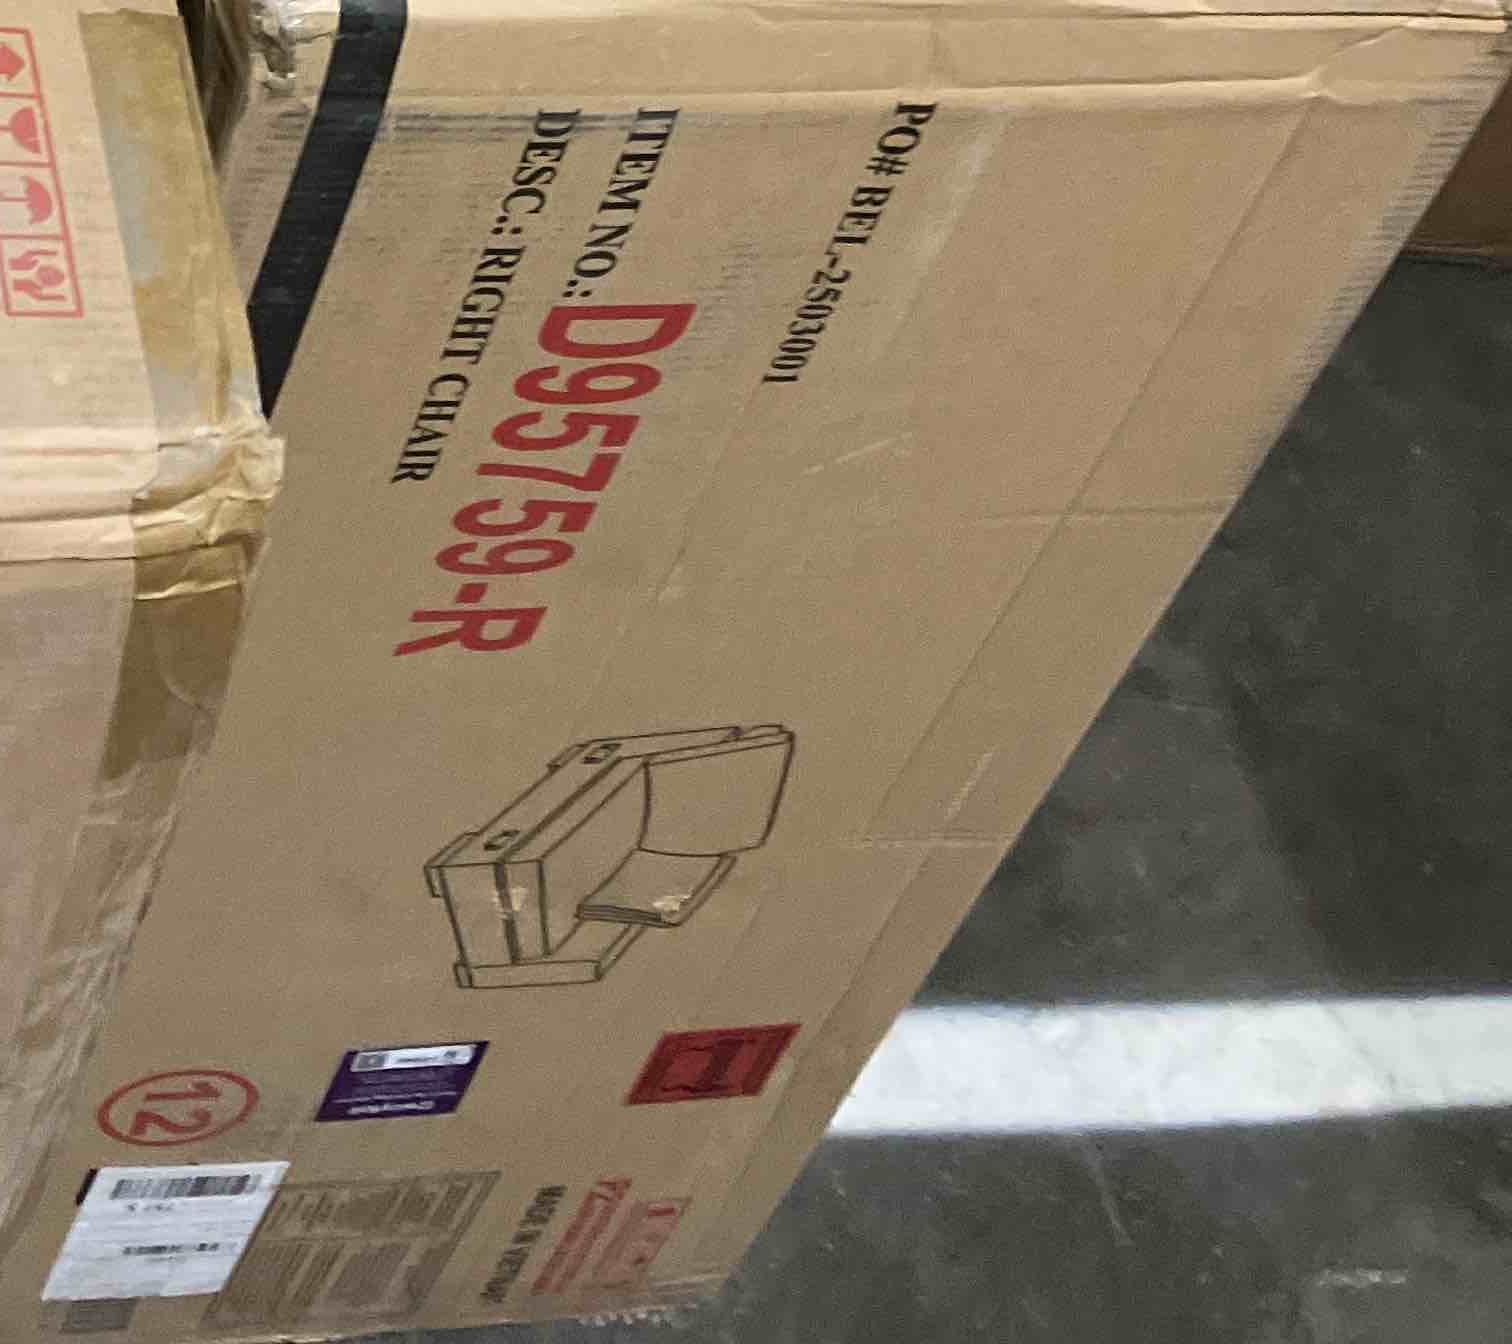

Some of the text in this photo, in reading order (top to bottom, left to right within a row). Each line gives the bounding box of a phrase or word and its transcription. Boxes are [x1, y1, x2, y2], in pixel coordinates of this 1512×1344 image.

[390, 108, 583, 485] DESC.: RIGHT CHAIR
[391, 108, 698, 657] ITEM NO.: D95759-R
[760, 101, 938, 386] PO# BEL-2503001
[128, 1081, 222, 1138] 12
[519, 1185, 568, 1226] MADE
